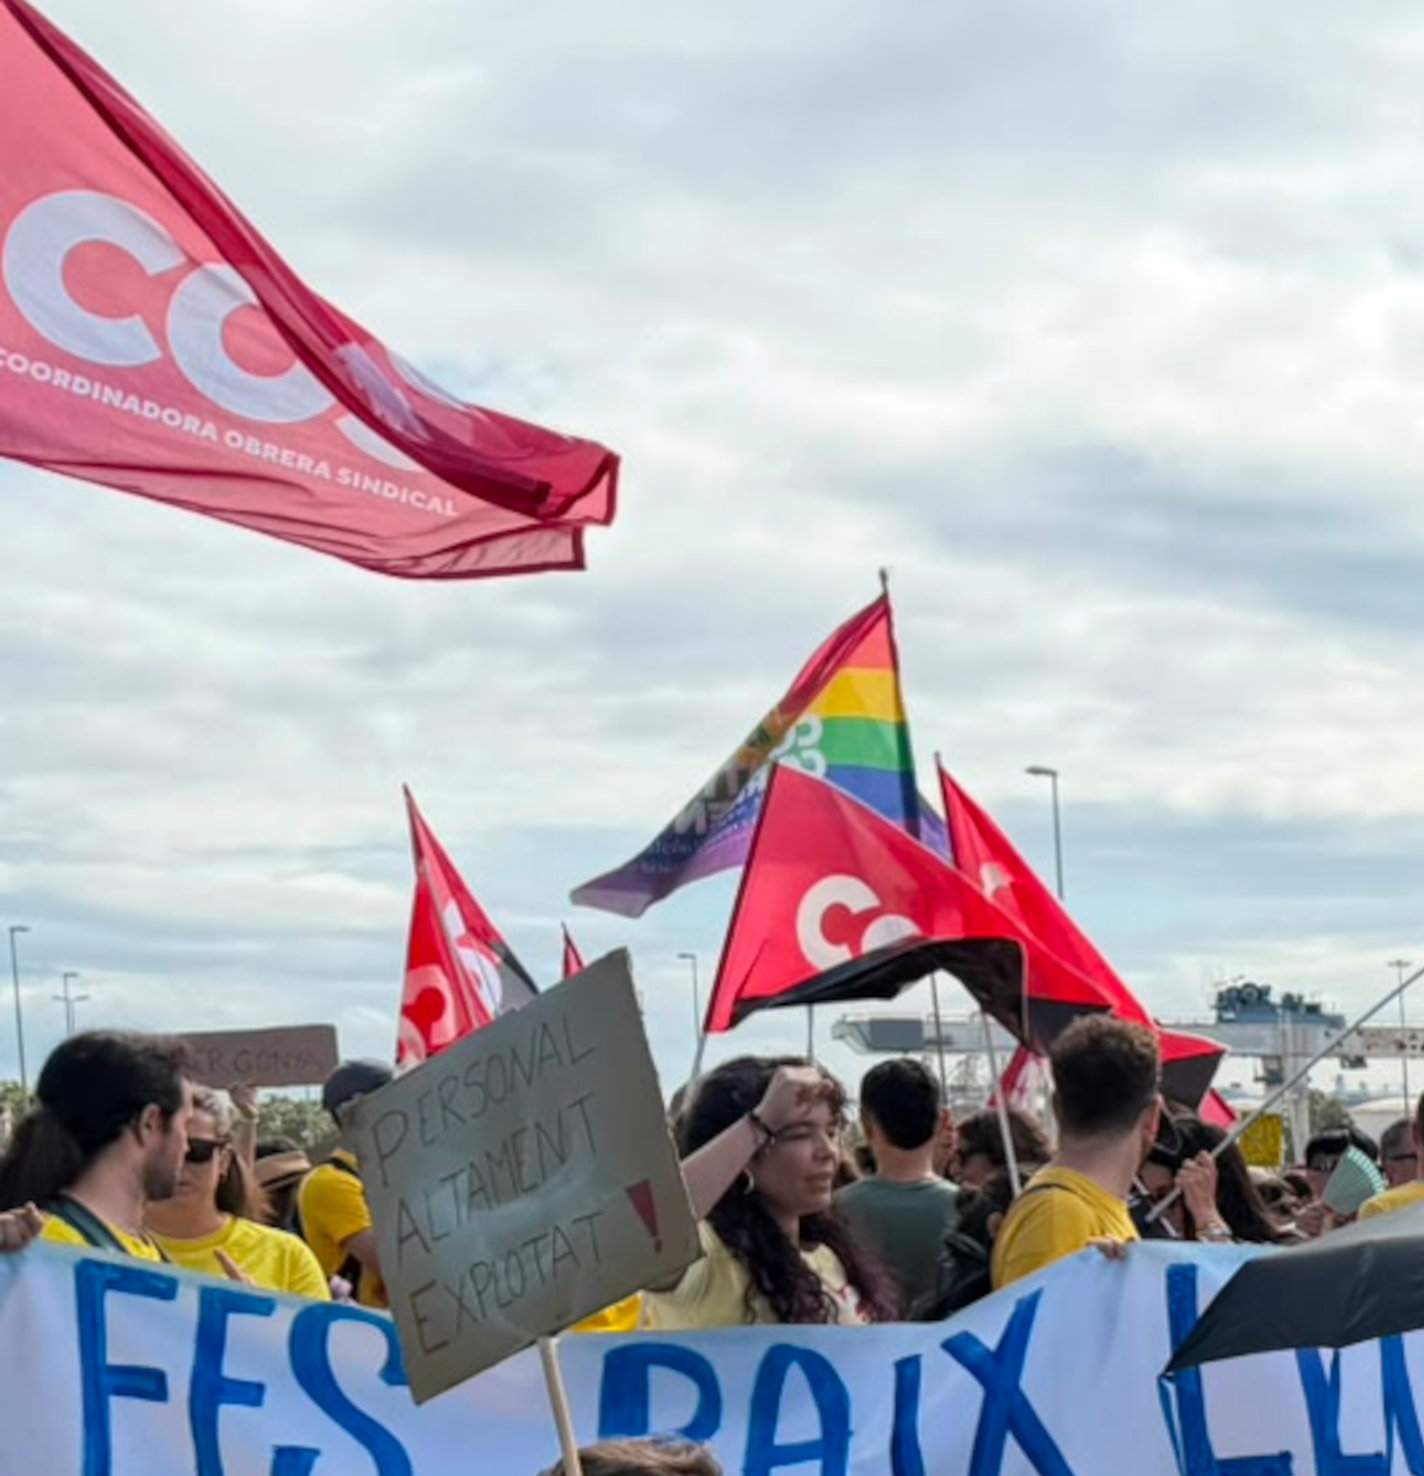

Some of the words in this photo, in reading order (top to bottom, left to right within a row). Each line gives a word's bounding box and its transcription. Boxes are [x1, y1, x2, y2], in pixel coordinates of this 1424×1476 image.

[224, 430, 332, 483] OBRERA
[336, 466, 461, 518] SINDICAL
[370, 1010, 596, 1188] PERSONAL
[394, 1088, 603, 1258] ALTAMENT
[408, 1210, 606, 1356] EXPLOTAT
